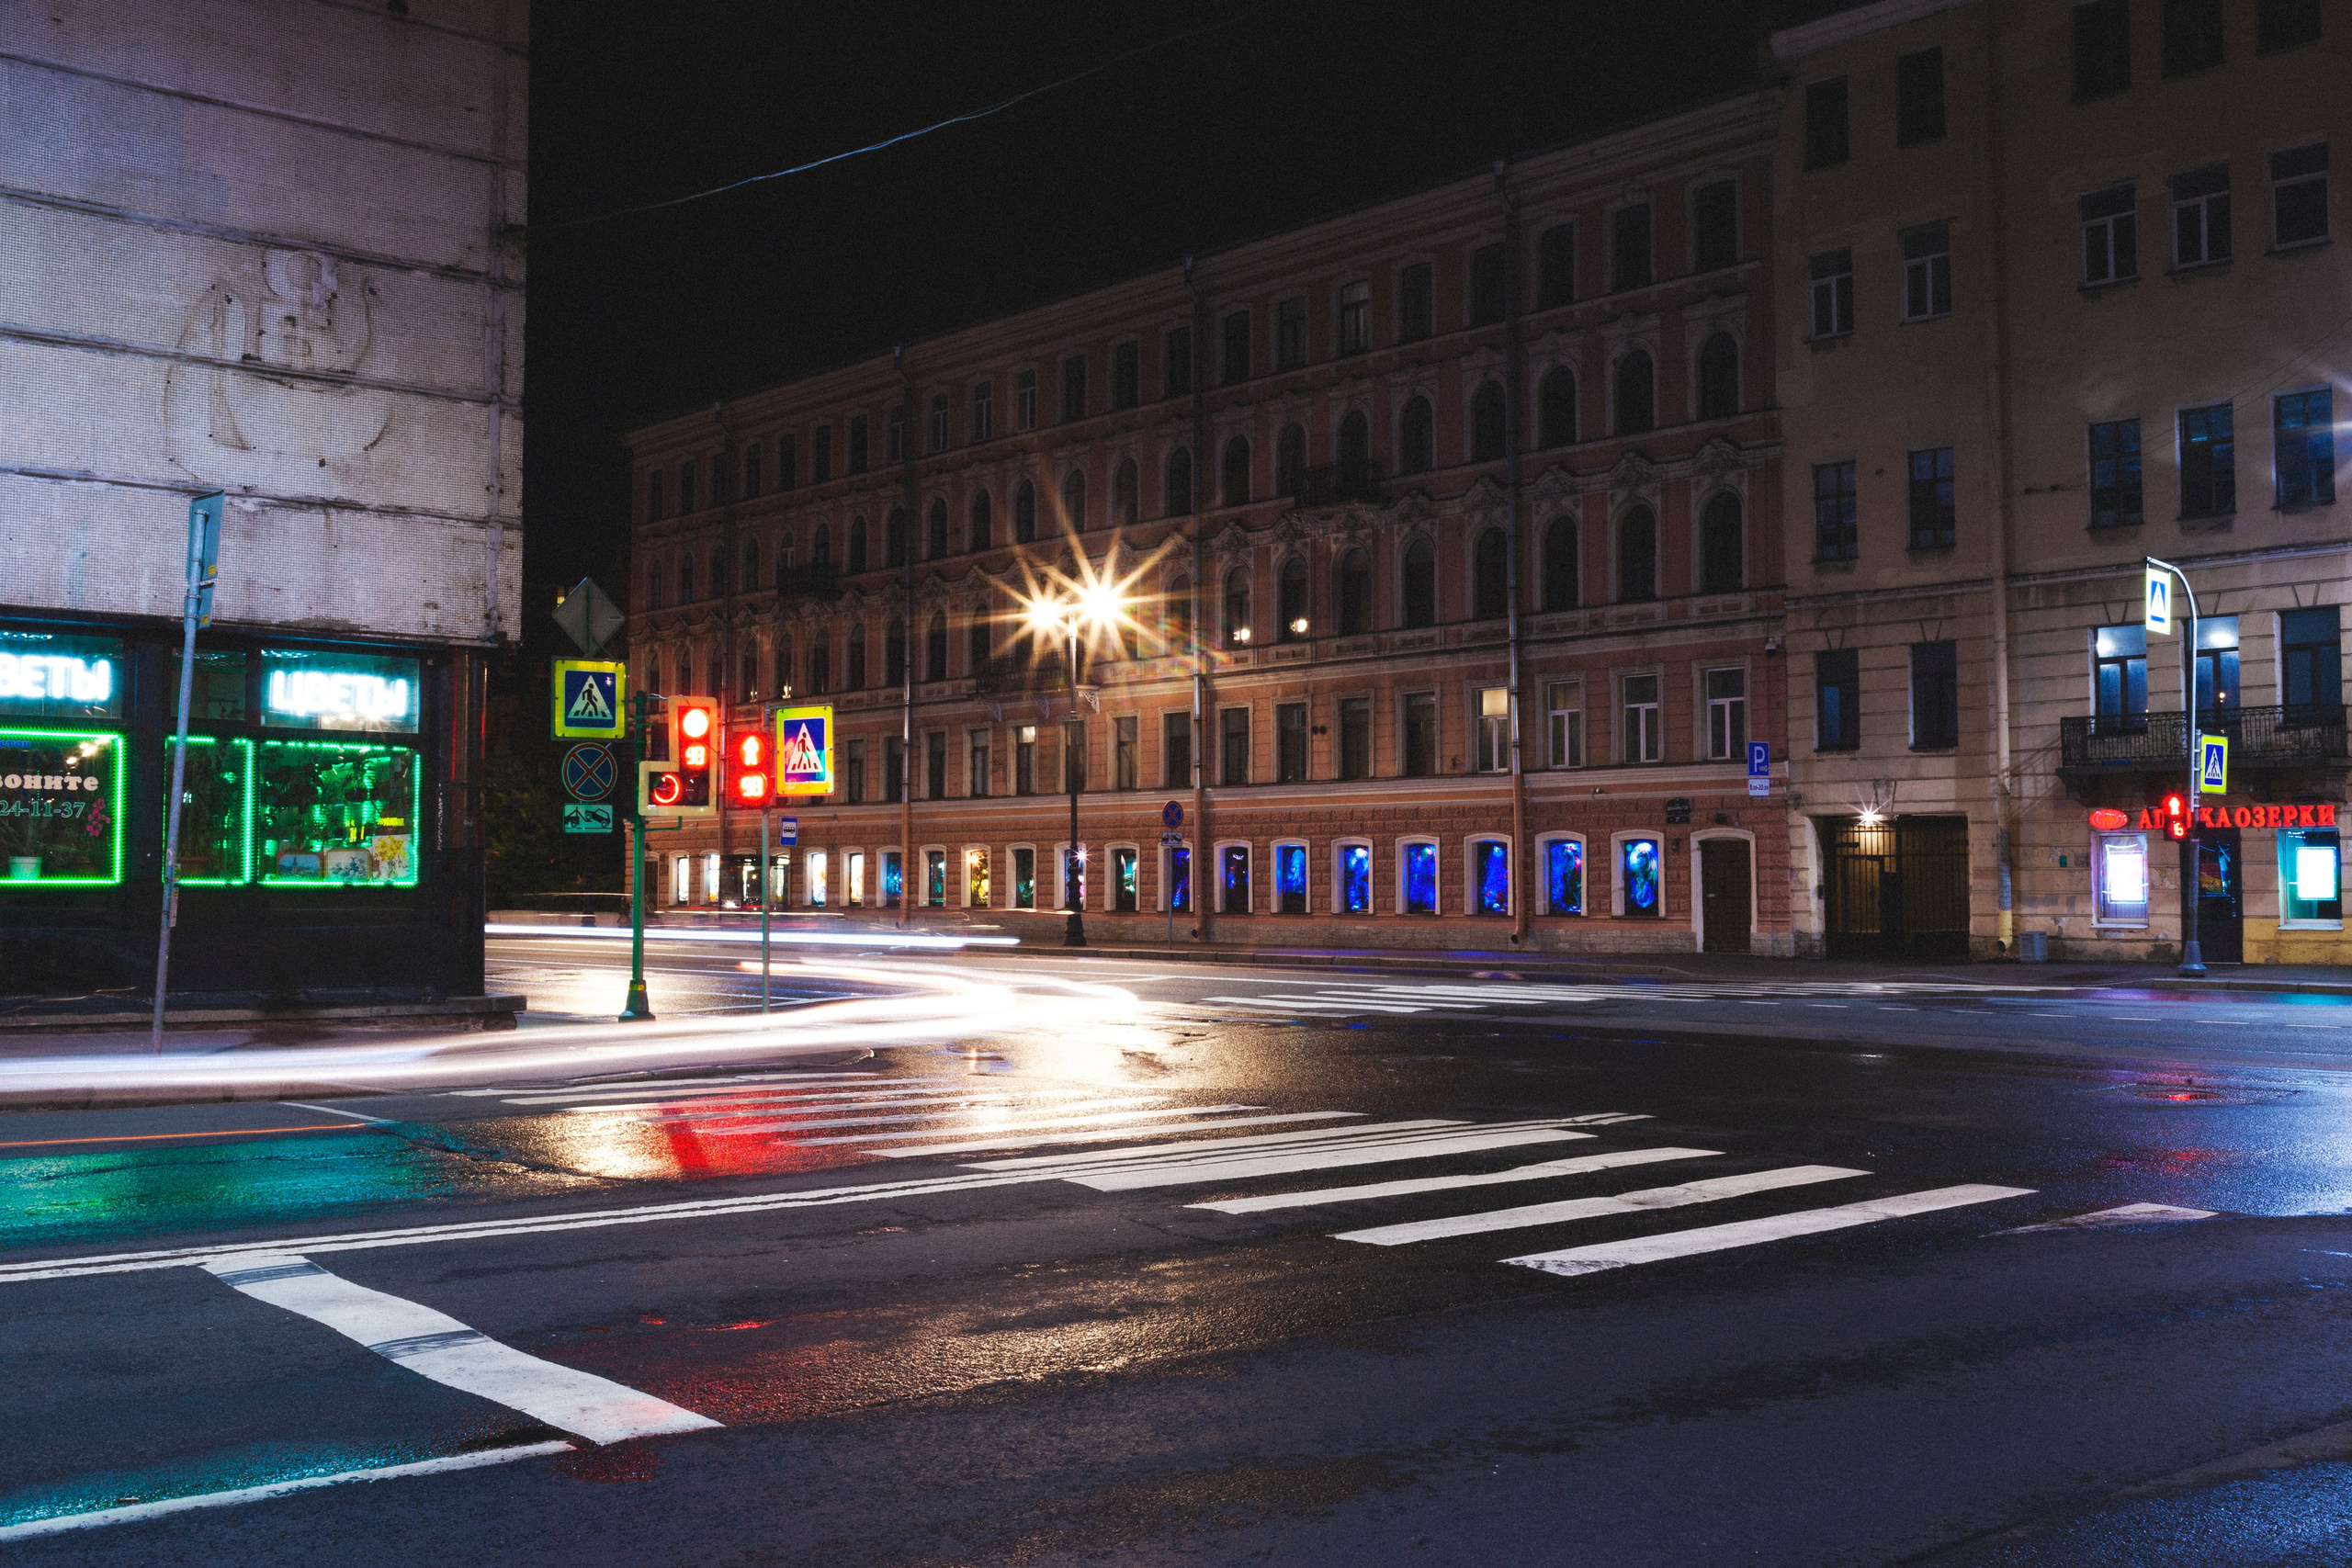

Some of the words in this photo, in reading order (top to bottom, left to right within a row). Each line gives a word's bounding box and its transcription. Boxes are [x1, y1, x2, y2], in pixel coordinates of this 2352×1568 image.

[270, 670, 407, 716] ЦВЕТЫ
[1754, 746, 1765, 773] P
[0, 773, 99, 791] оните
[2234, 805, 2335, 828] ОЗЕРКИ
